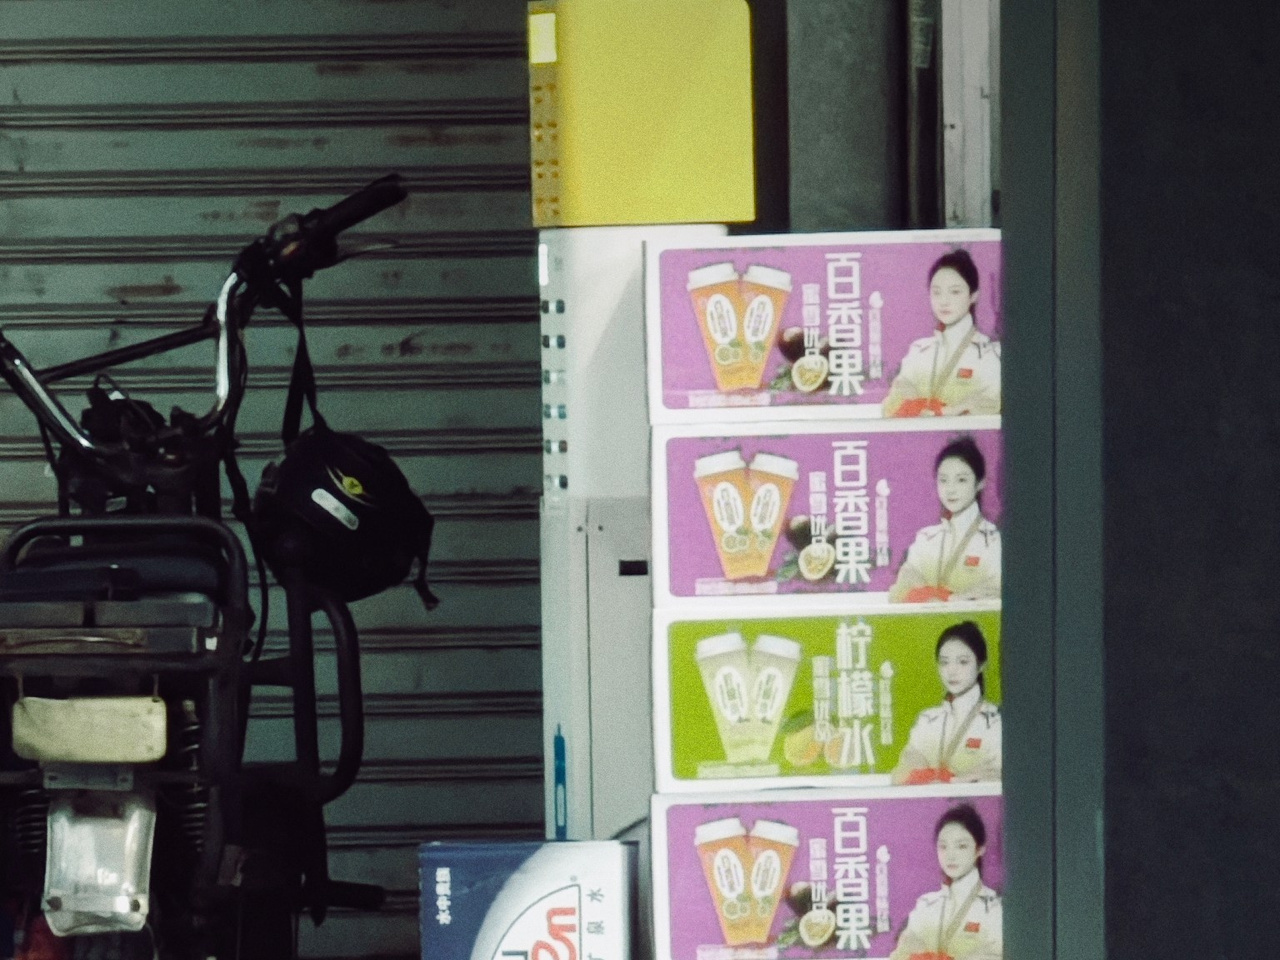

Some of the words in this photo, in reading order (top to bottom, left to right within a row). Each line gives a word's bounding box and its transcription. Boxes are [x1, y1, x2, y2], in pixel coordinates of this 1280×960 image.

[825, 252, 864, 395] 百香果
[832, 440, 871, 584] 百香果
[836, 622, 875, 767] 柠檬水
[831, 807, 872, 951] 百香果
